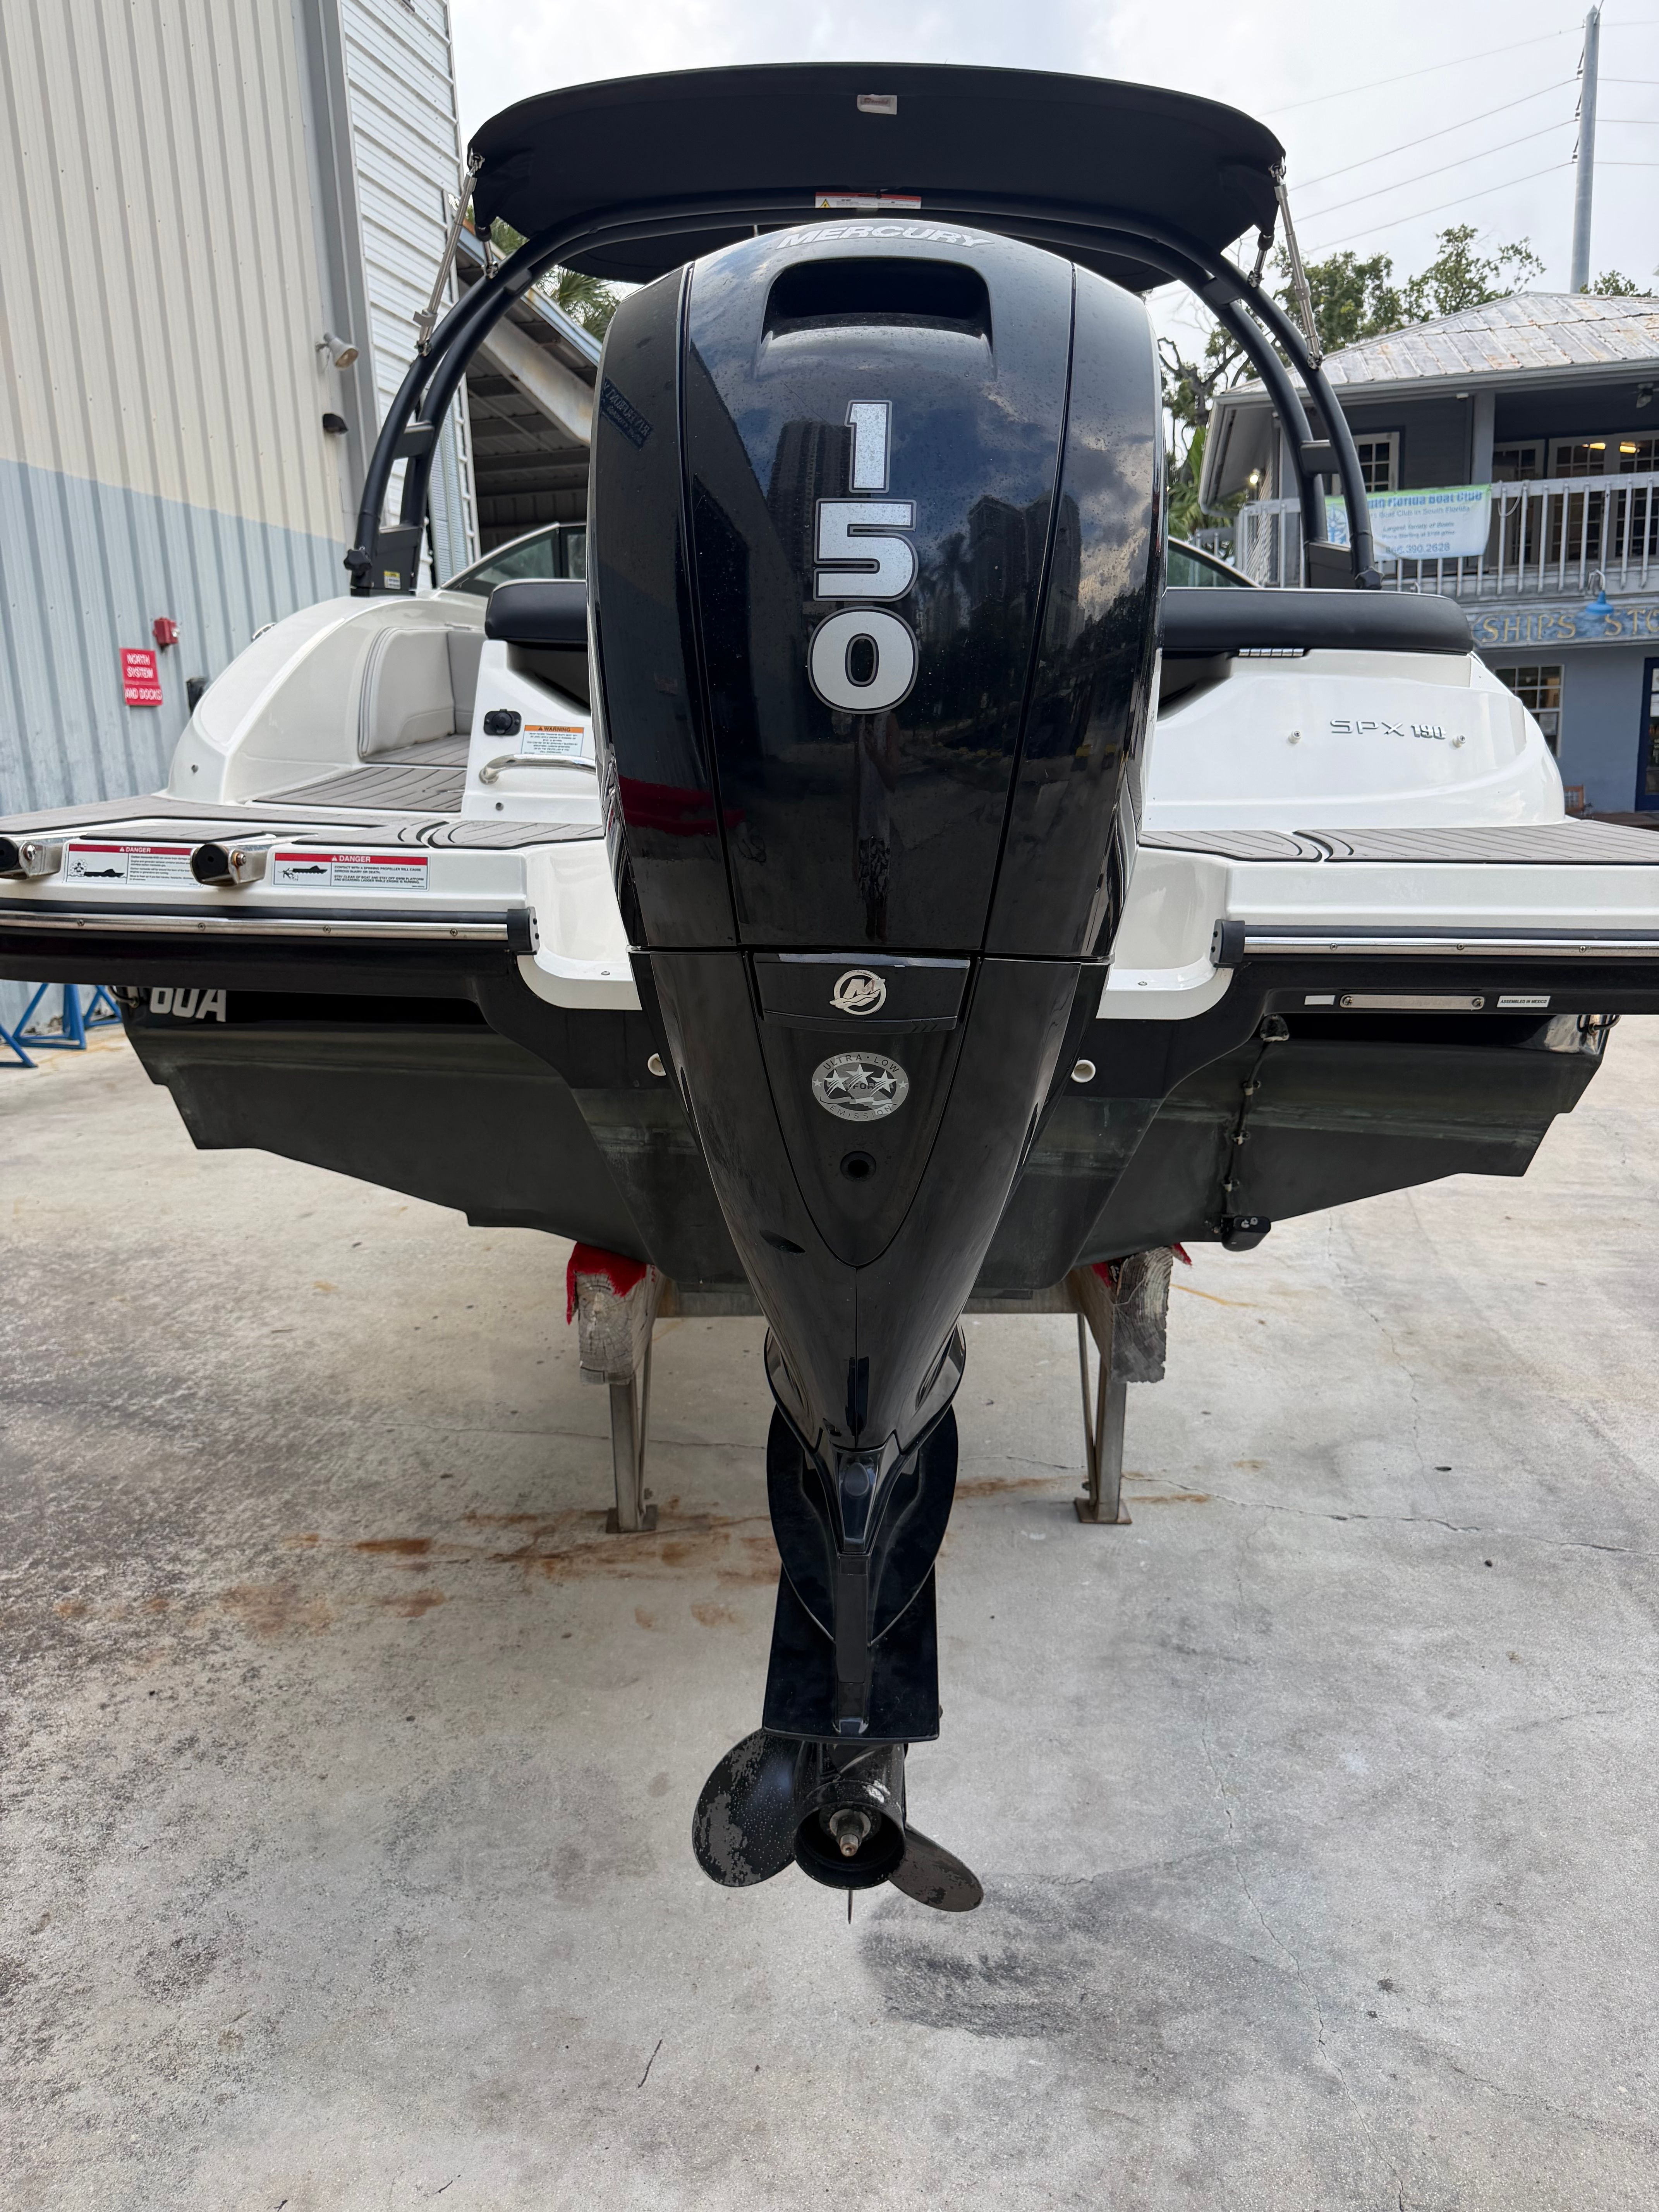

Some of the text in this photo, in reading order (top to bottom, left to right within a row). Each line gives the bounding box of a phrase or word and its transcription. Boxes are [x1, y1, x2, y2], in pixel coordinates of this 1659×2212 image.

[775, 226, 994, 250] MERCURY
[808, 400, 919, 714] 150
[1482, 613, 1577, 643] SHIPS
[127, 653, 151, 665] NORTH
[127, 666, 154, 678] SYSTEM
[139, 688, 162, 700] DOCKS
[1330, 720, 1447, 740] SPX 190
[823, 1054, 900, 1073] ULTRA LOW
[830, 1105, 892, 1119] EMISSION
